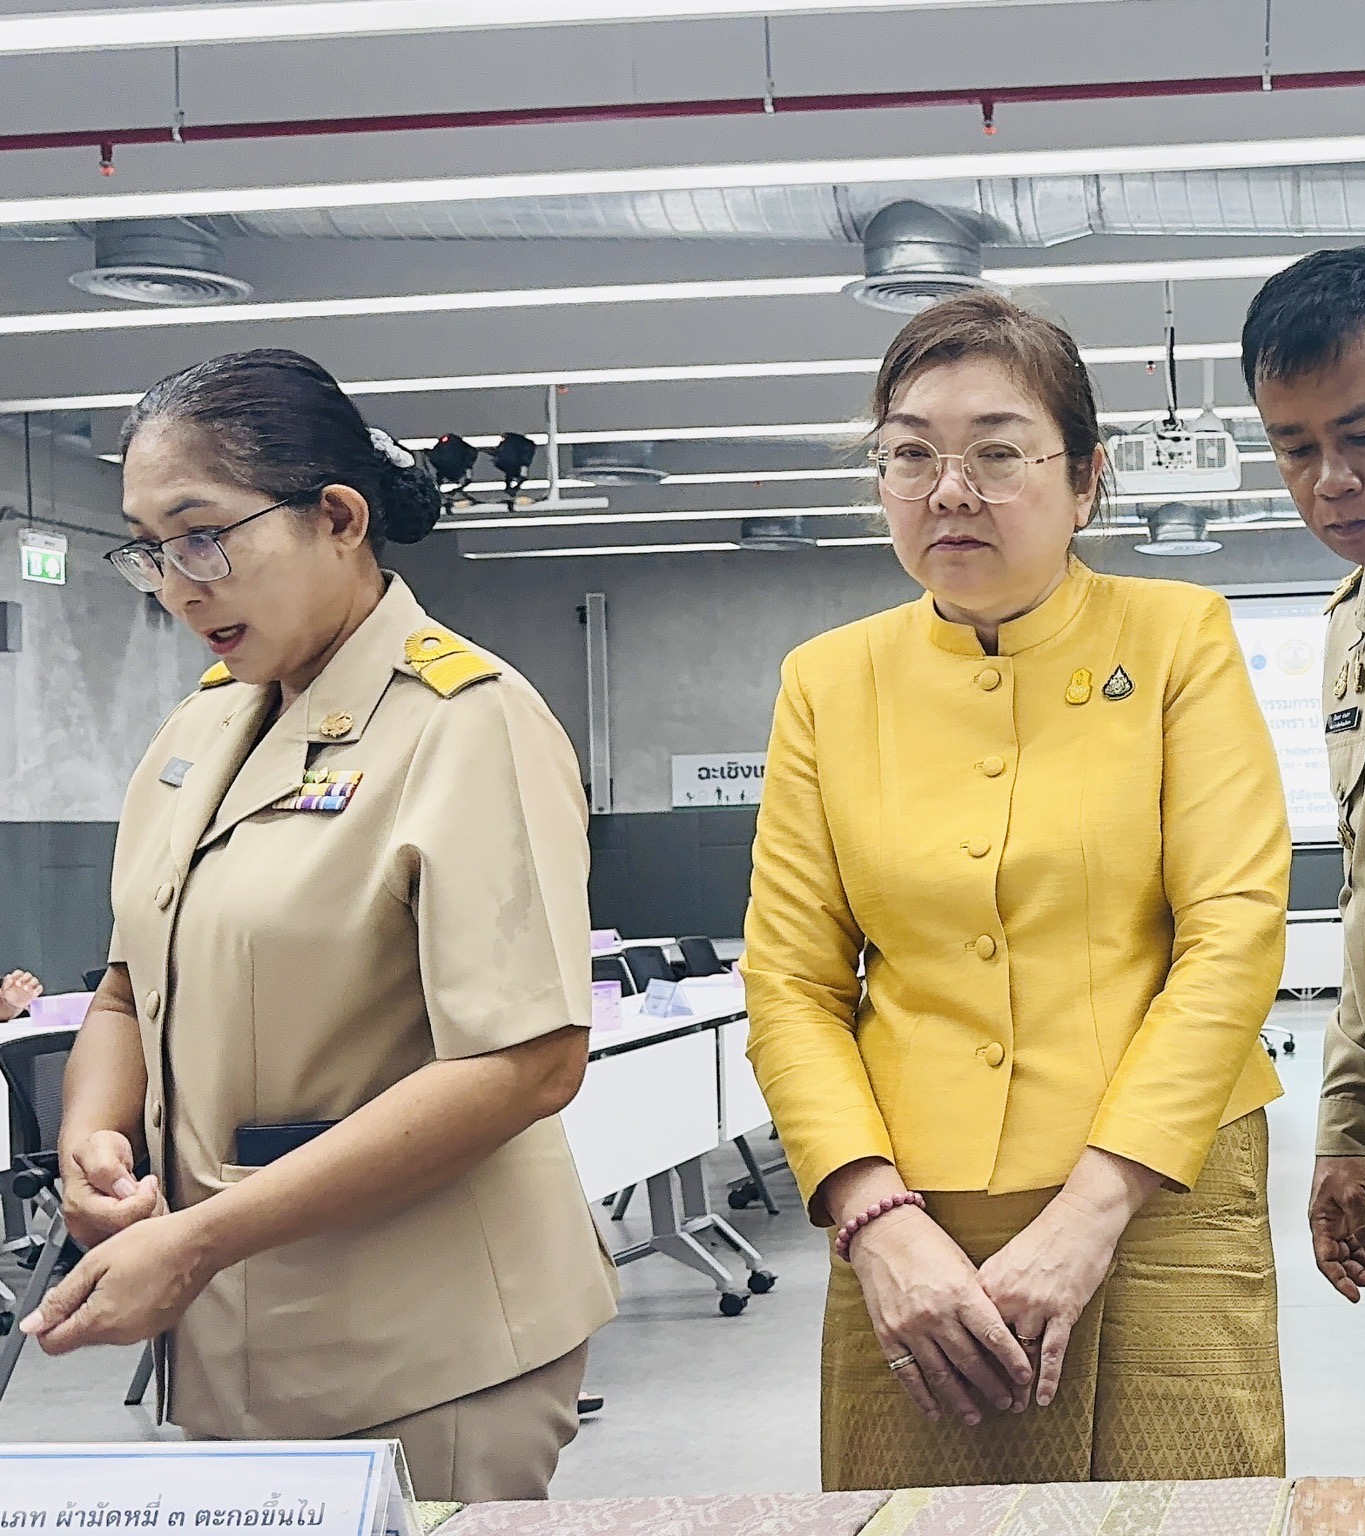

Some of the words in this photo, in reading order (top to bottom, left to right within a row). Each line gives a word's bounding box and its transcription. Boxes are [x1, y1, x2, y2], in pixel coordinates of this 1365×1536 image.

[55, 1493, 163, 1528] ผ้ามัดหมี่
[167, 1510, 186, 1527] ๓
[194, 1492, 326, 1528] ตะกอขึ้นไป
